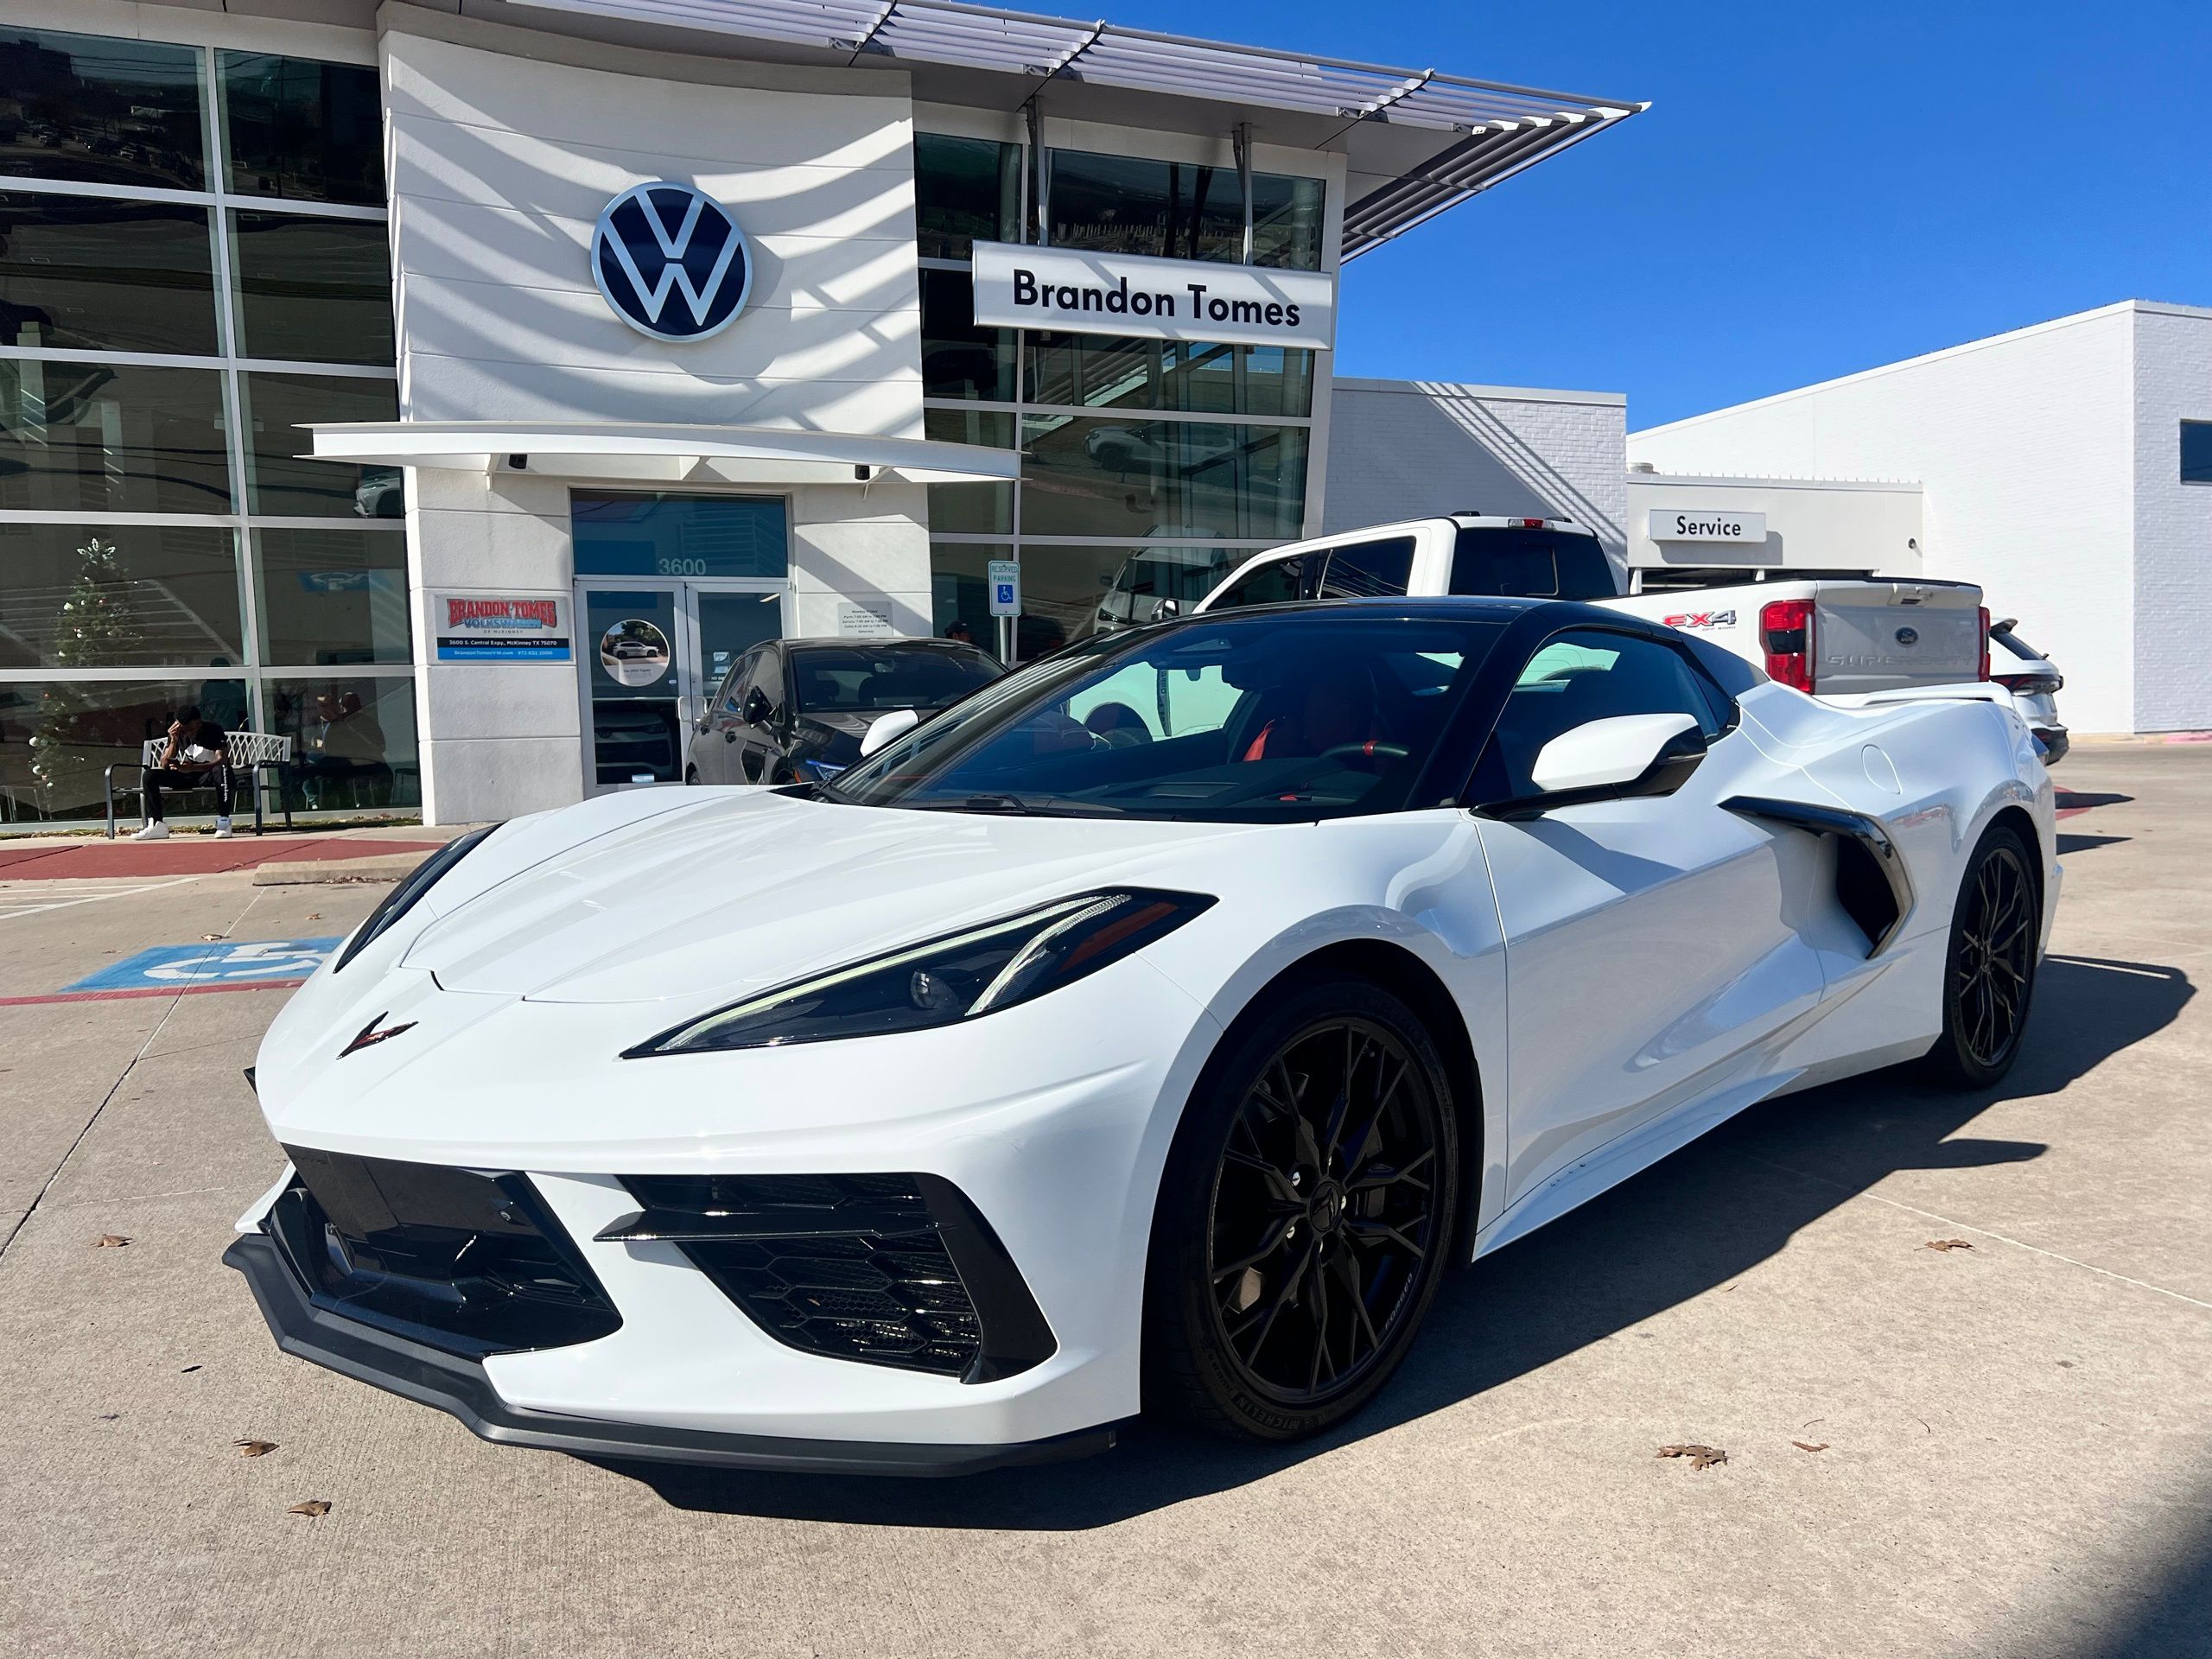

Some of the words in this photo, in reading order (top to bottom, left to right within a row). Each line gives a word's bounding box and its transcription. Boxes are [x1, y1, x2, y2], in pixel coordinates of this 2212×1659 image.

[1013, 268, 1175, 317] Brandon
[1187, 283, 1300, 327] Tomes
[1676, 515, 1741, 536] Service
[658, 558, 707, 575] 3600
[447, 599, 512, 628] BRANDON
[512, 600, 558, 628] TOMES
[1662, 609, 1736, 628] FX4
[1828, 655, 1912, 666] SUPER
[1236, 1395, 1302, 1431] MICHELIN
